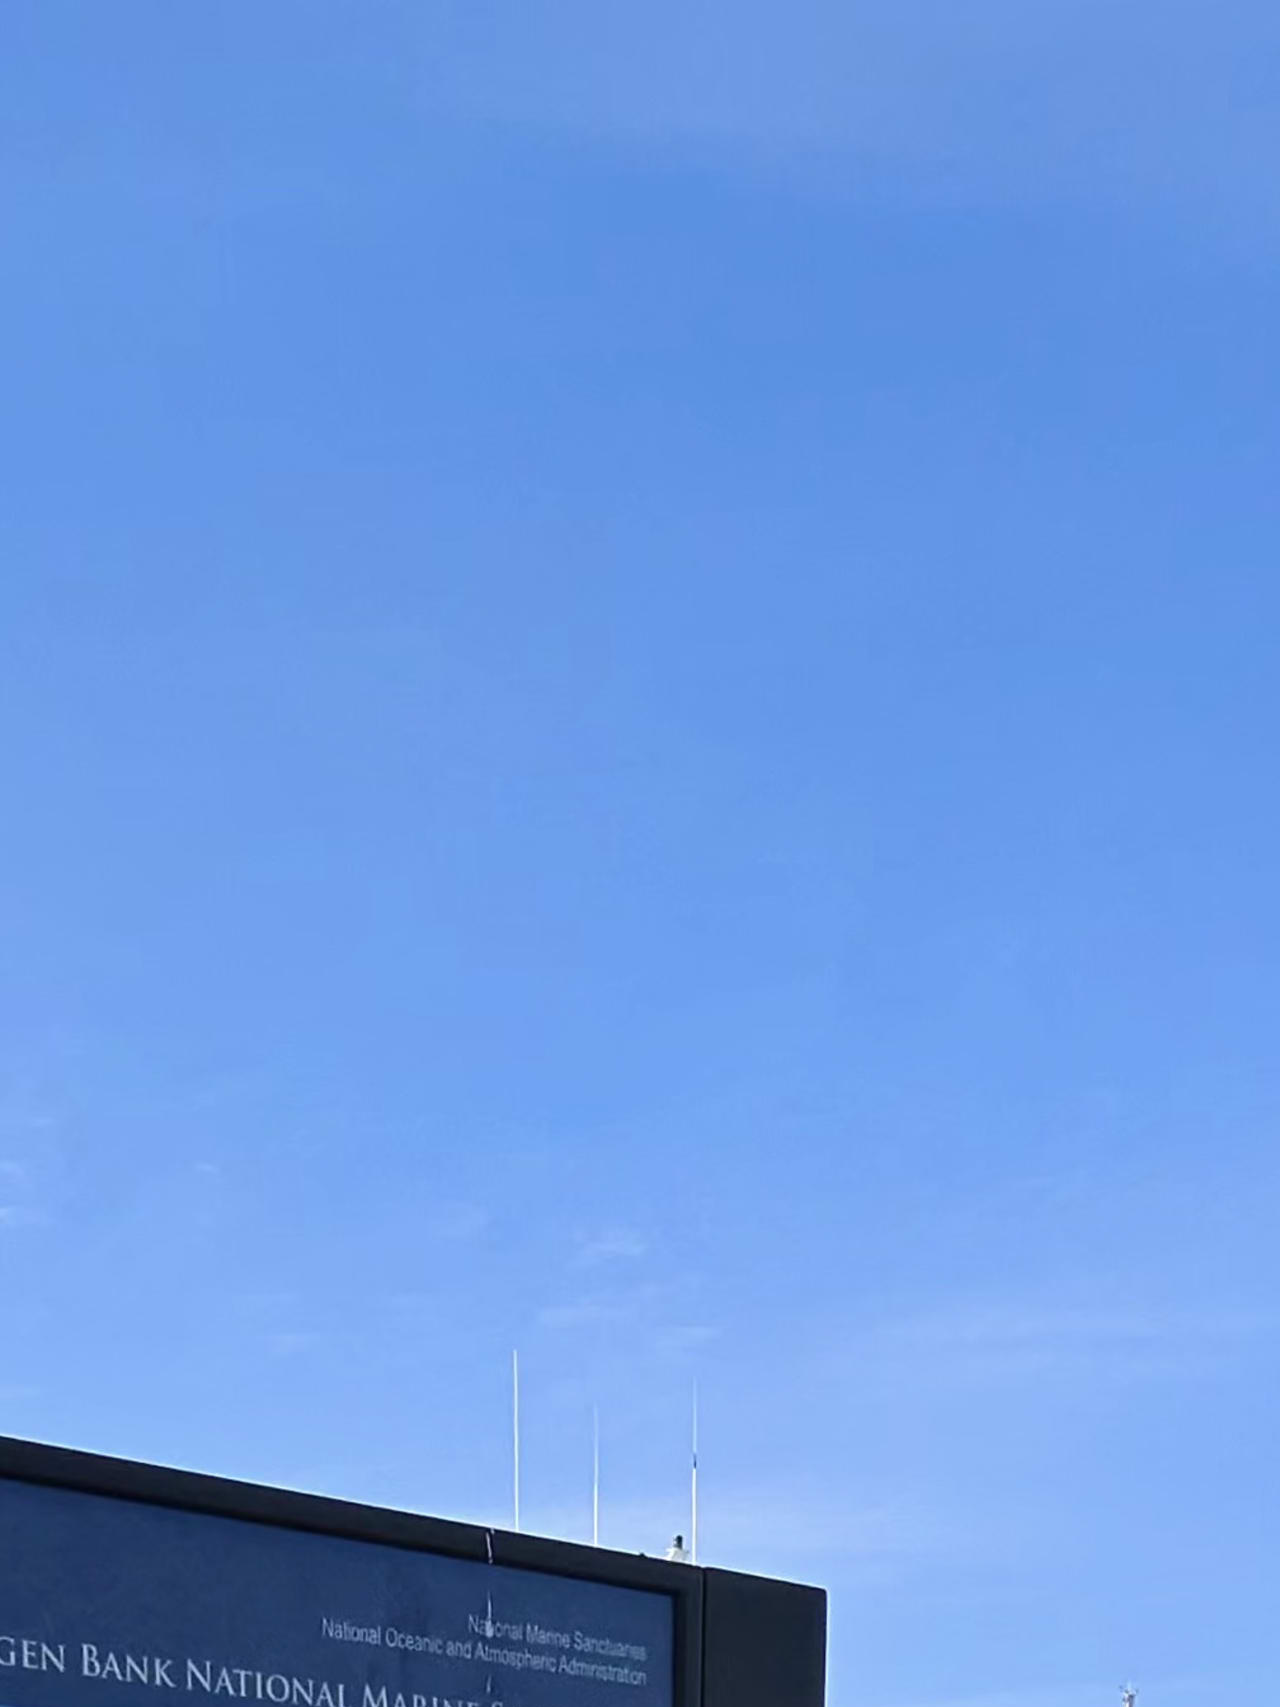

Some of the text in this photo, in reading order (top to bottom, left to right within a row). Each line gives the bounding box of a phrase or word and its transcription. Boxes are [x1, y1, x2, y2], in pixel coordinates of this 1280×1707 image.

[323, 1618, 646, 1684] National Oceanic and Atmospheric Administration
[526, 1623, 570, 1648] Marine
[82, 1644, 176, 1687] BANK
